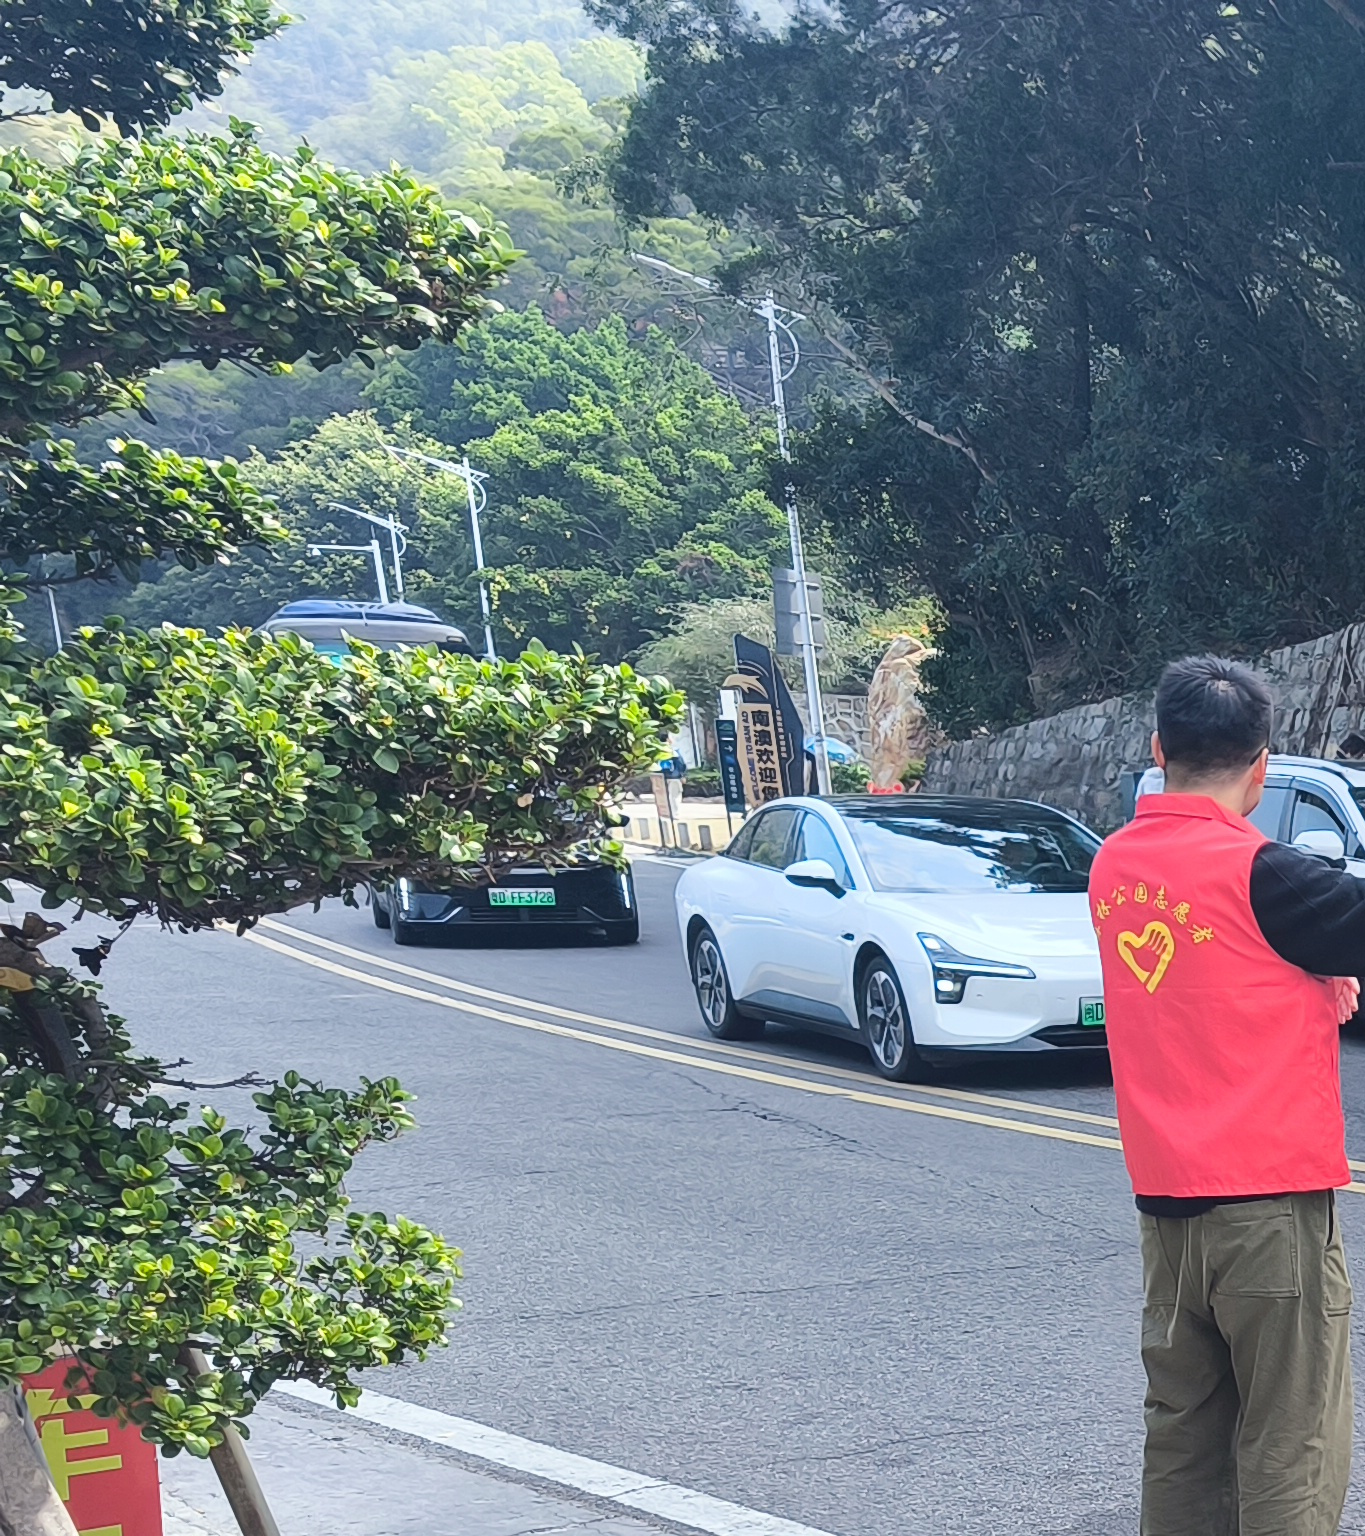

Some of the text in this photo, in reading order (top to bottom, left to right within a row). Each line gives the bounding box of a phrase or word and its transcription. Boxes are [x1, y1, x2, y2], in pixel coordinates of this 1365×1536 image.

[751, 709, 780, 802] 南澳欢迎您
